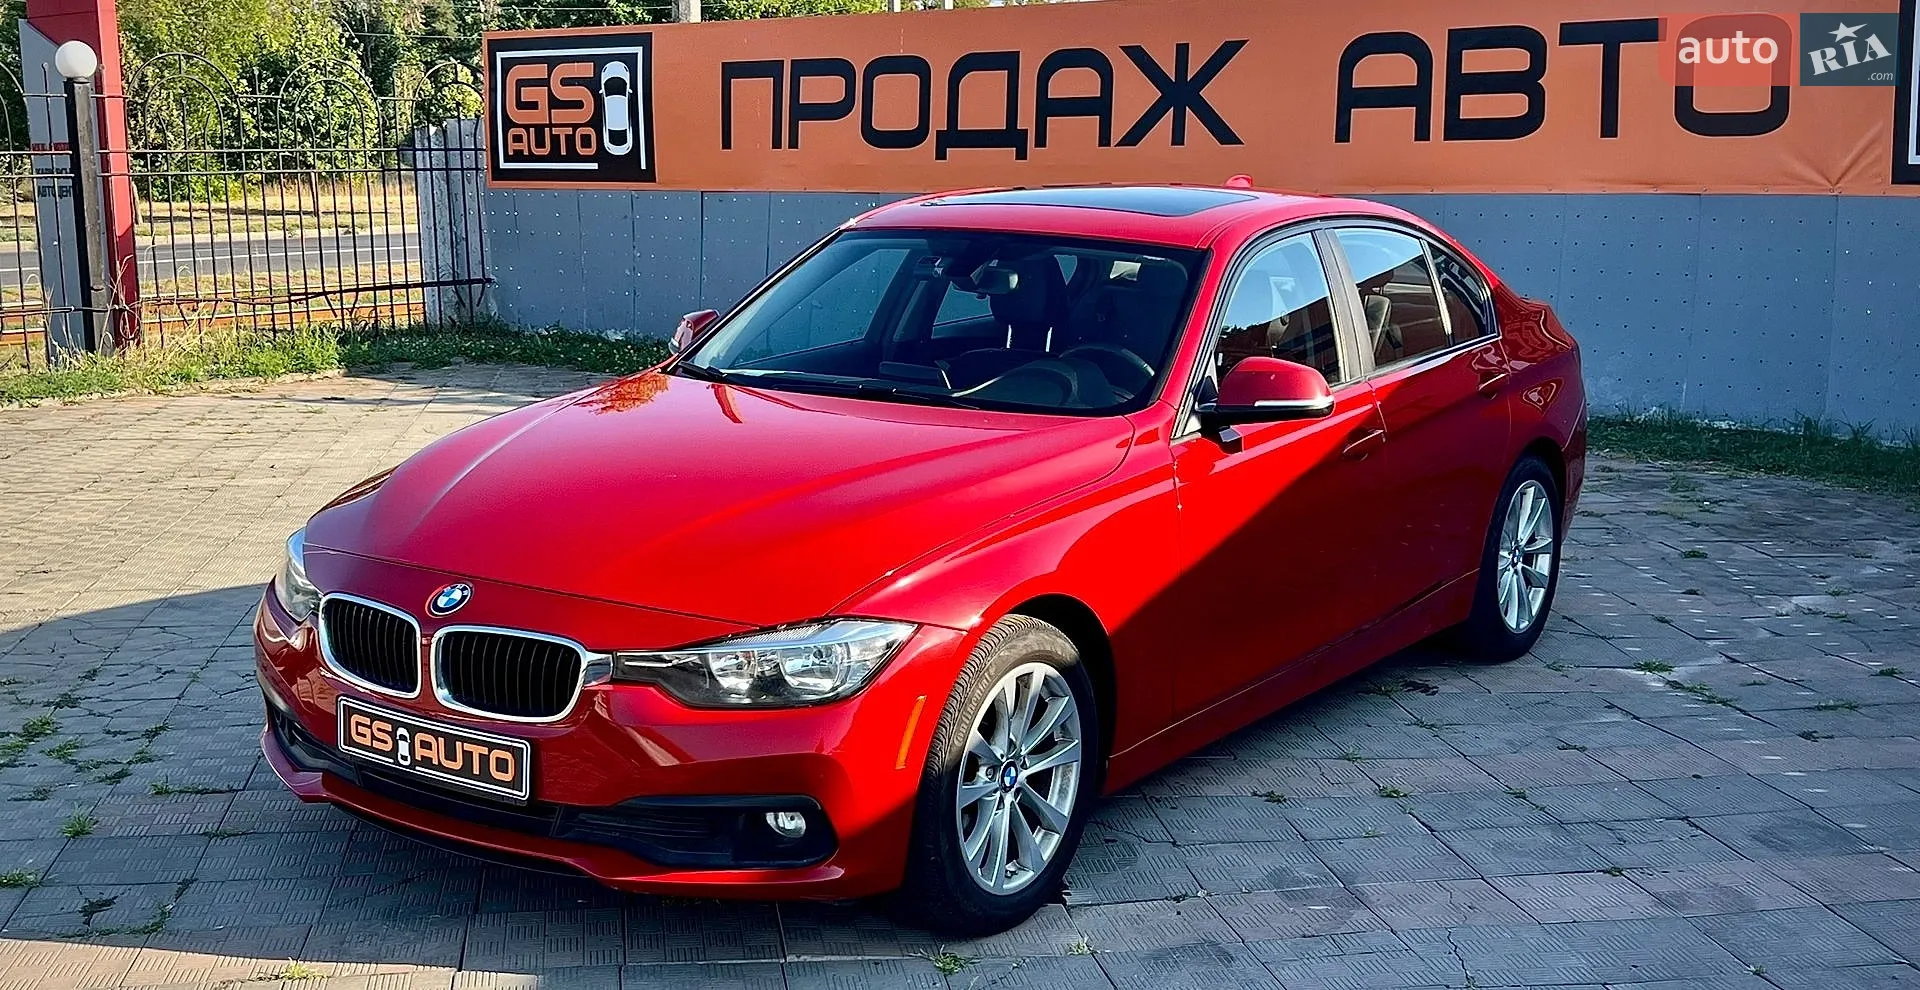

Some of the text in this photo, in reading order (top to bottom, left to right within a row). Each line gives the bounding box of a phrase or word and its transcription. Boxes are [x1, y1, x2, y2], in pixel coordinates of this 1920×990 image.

[505, 62, 595, 125] GS
[720, 13, 1793, 161] ПРОДАЖ АВТО
[507, 127, 597, 156] AUTO
[350, 713, 515, 782] GS AUTO
